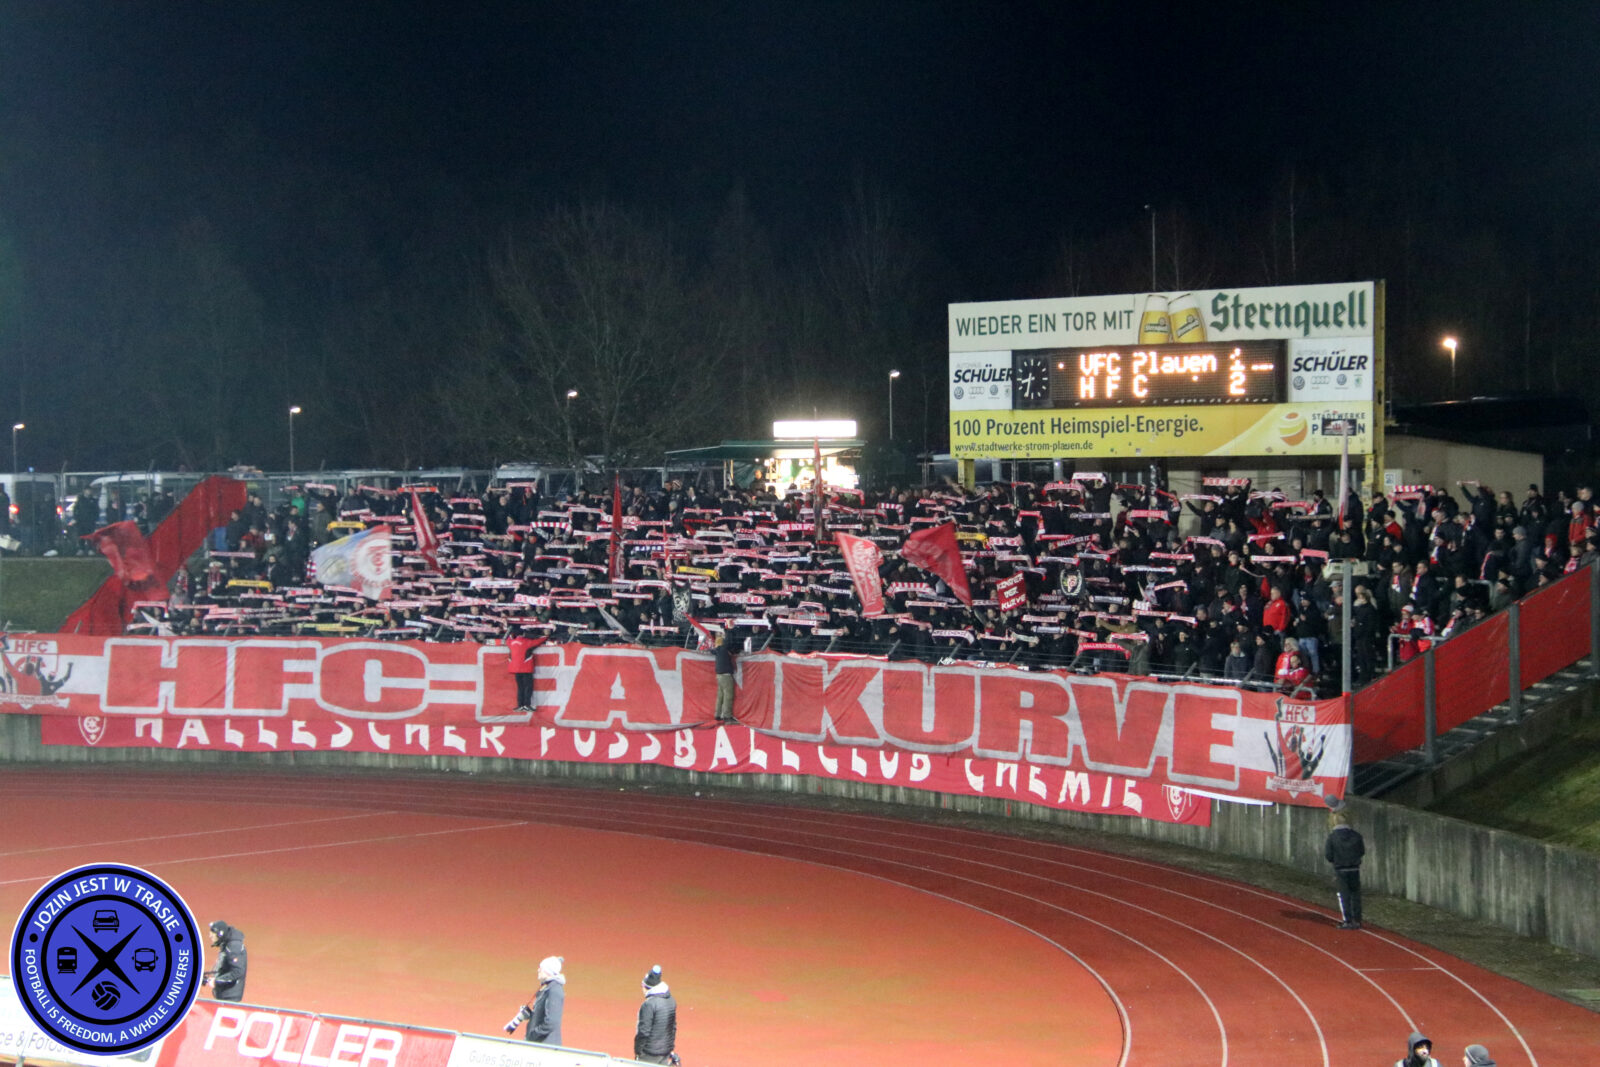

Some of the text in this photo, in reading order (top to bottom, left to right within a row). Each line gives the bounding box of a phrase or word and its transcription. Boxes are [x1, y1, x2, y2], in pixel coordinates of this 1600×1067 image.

[956, 310, 1134, 336] WIEDER EIN TOR MIT
[1210, 289, 1367, 337] Sternquell
[1079, 352, 1121, 376] VFC
[1132, 351, 1217, 374] Plauen
[1292, 351, 1368, 372] SCHÜLER
[1229, 372, 1245, 396] 2
[954, 414, 1204, 438] 100 Prozent Heimspiel-Energie.
[955, 440, 1093, 452] www.stadtwerke-strom-plauen.de
[14, 639, 48, 653] HFC
[1286, 704, 1310, 722] HFC
[203, 1006, 403, 1067] POLLER
